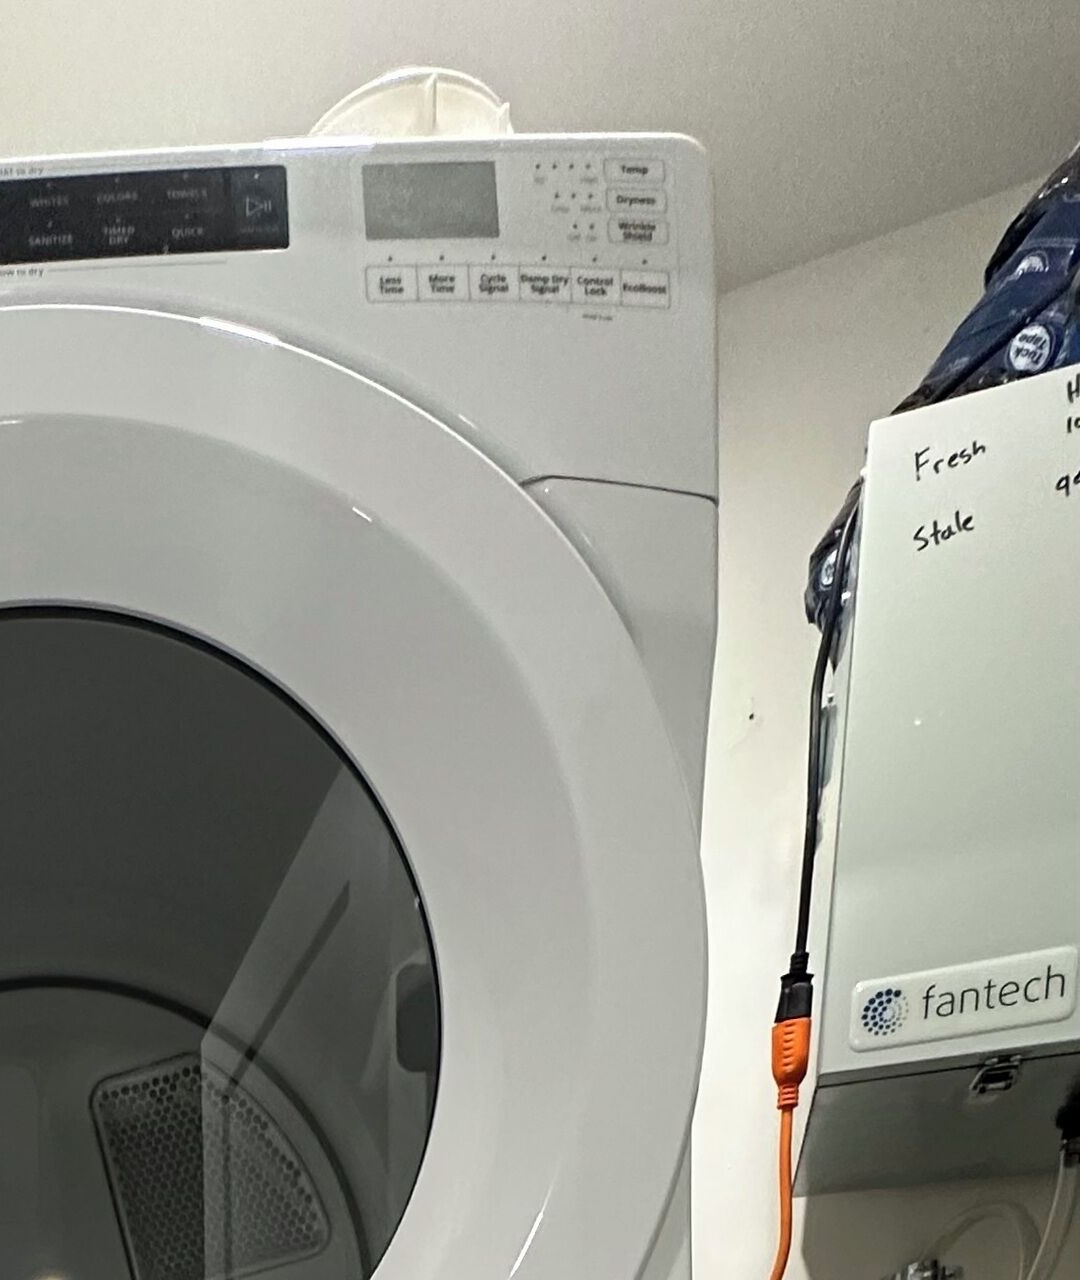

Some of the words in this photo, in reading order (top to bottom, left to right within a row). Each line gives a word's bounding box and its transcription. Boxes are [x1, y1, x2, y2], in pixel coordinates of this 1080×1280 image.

[28, 234, 72, 246] SANITIZE
[429, 273, 455, 283] More
[480, 273, 506, 284] Cycle
[520, 274, 549, 284] Damp
[551, 274, 569, 286] Dry
[577, 275, 613, 286] Control
[479, 283, 509, 294] Signal
[531, 284, 559, 295] Signal
[584, 286, 607, 296] Lock
[1018, 333, 1047, 350] Tape
[1015, 346, 1044, 365] Tuck
[915, 440, 986, 481] Fresh
[913, 510, 974, 551] Stale
[922, 964, 1066, 1020] fantech
